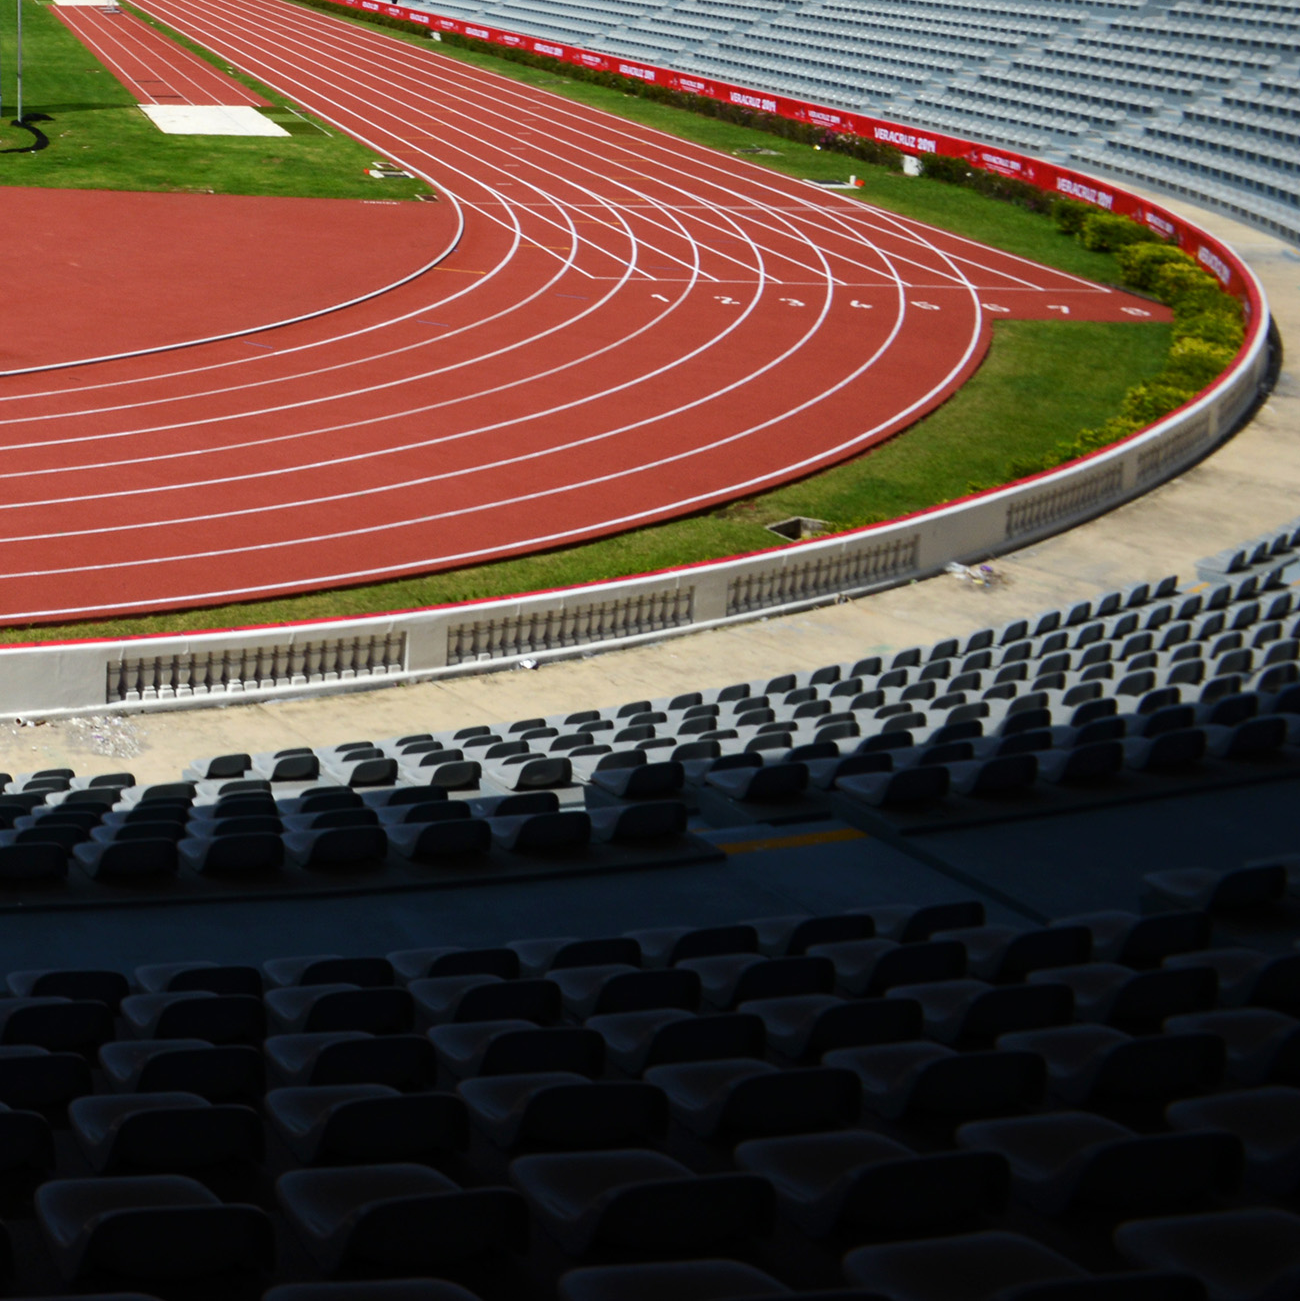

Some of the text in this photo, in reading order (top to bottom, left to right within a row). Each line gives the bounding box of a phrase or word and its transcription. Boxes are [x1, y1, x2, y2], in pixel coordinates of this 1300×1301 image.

[874, 128, 915, 147] VERACRUZ
[714, 296, 740, 304] 2
[779, 298, 805, 306] 3
[1047, 305, 1069, 314] 7
